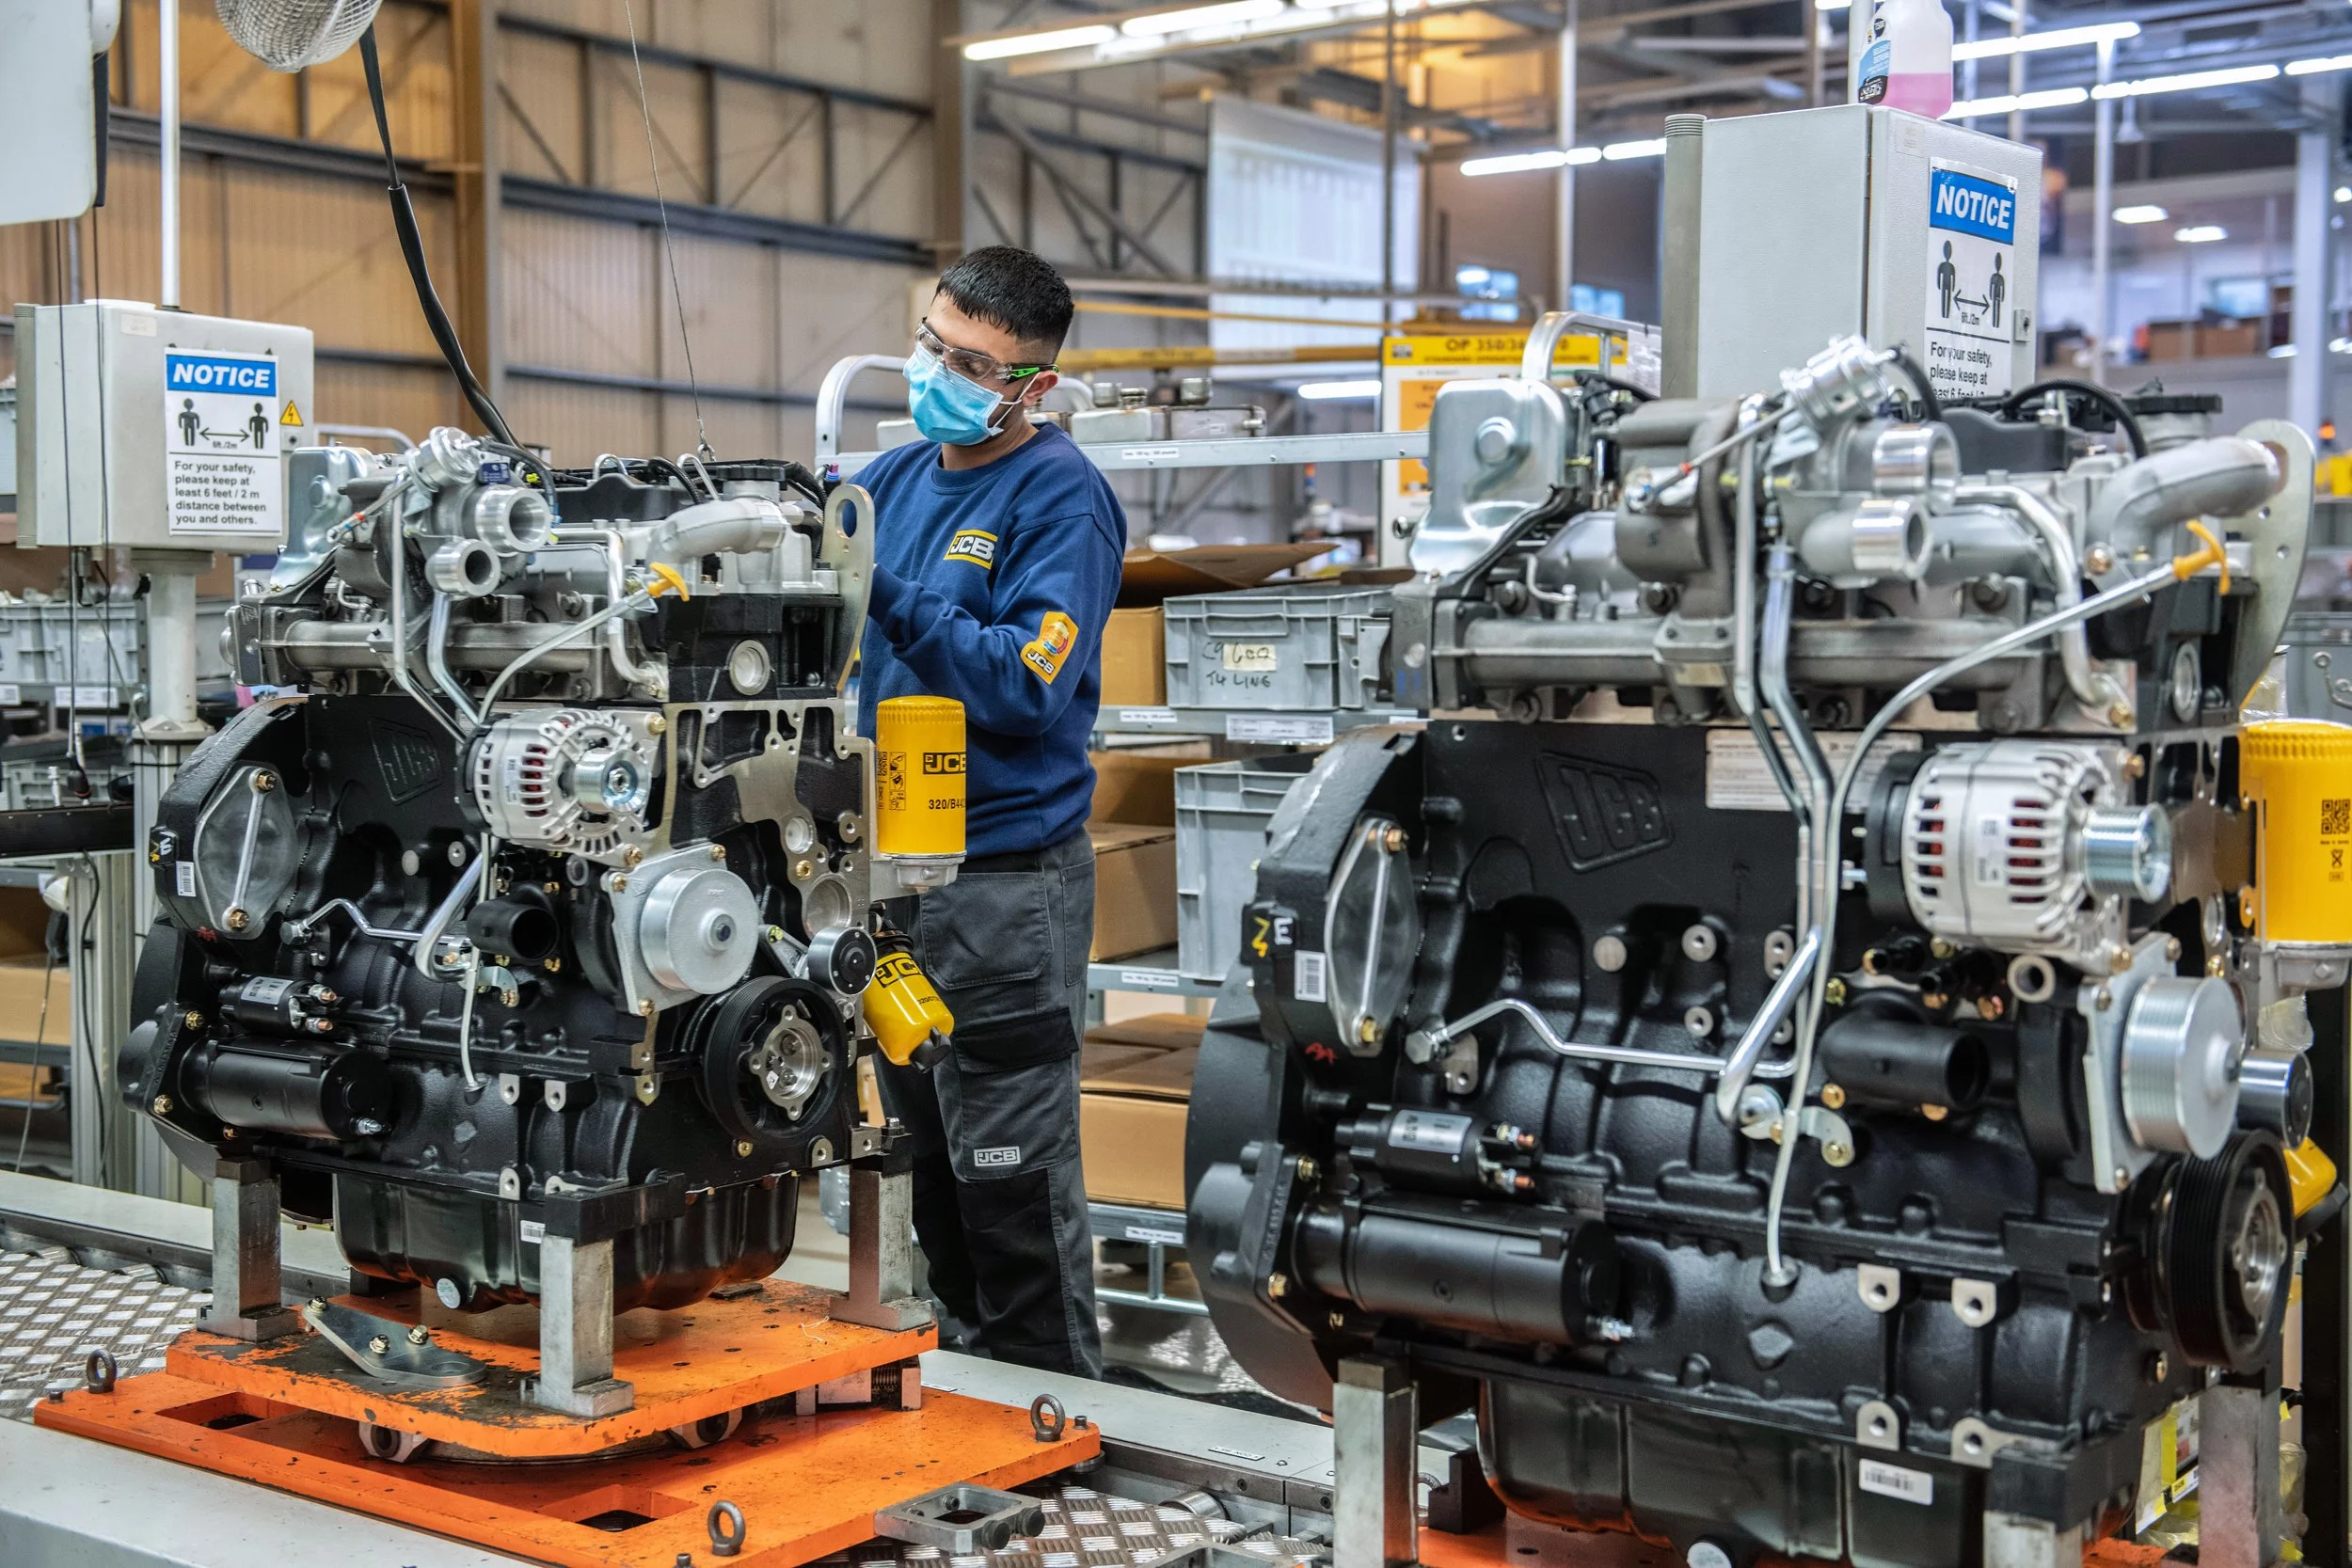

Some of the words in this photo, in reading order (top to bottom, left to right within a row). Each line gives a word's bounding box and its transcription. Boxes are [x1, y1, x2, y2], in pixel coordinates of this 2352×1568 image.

[1935, 183, 2012, 230] NOTICE
[1931, 341, 1947, 357] For
[1947, 347, 1965, 362] your
[1966, 349, 1993, 368] safety,
[172, 363, 271, 388] NOTICE
[1930, 364, 1956, 381] please
[1959, 367, 1978, 387] keep
[1979, 372, 1987, 386] at
[174, 461, 193, 470] For
[196, 464, 219, 473] your
[222, 463, 256, 475] safety,
[175, 474, 210, 484] please
[213, 476, 237, 486] keep
[240, 477, 250, 485] at
[175, 487, 201, 497] least
[204, 488, 210, 498] 6
[213, 488, 232, 498] feet
[234, 489, 239, 499] /
[241, 489, 247, 499] 2
[175, 500, 220, 510] distance
[223, 501, 266, 512] between
[176, 515, 196, 525] you
[199, 515, 218, 524] and
[221, 515, 258, 524] others.
[949, 535, 995, 561] JCB
[1026, 651, 1055, 674] JCB
[1233, 673, 1271, 689] LINE
[978, 1150, 1017, 1164] JCB
